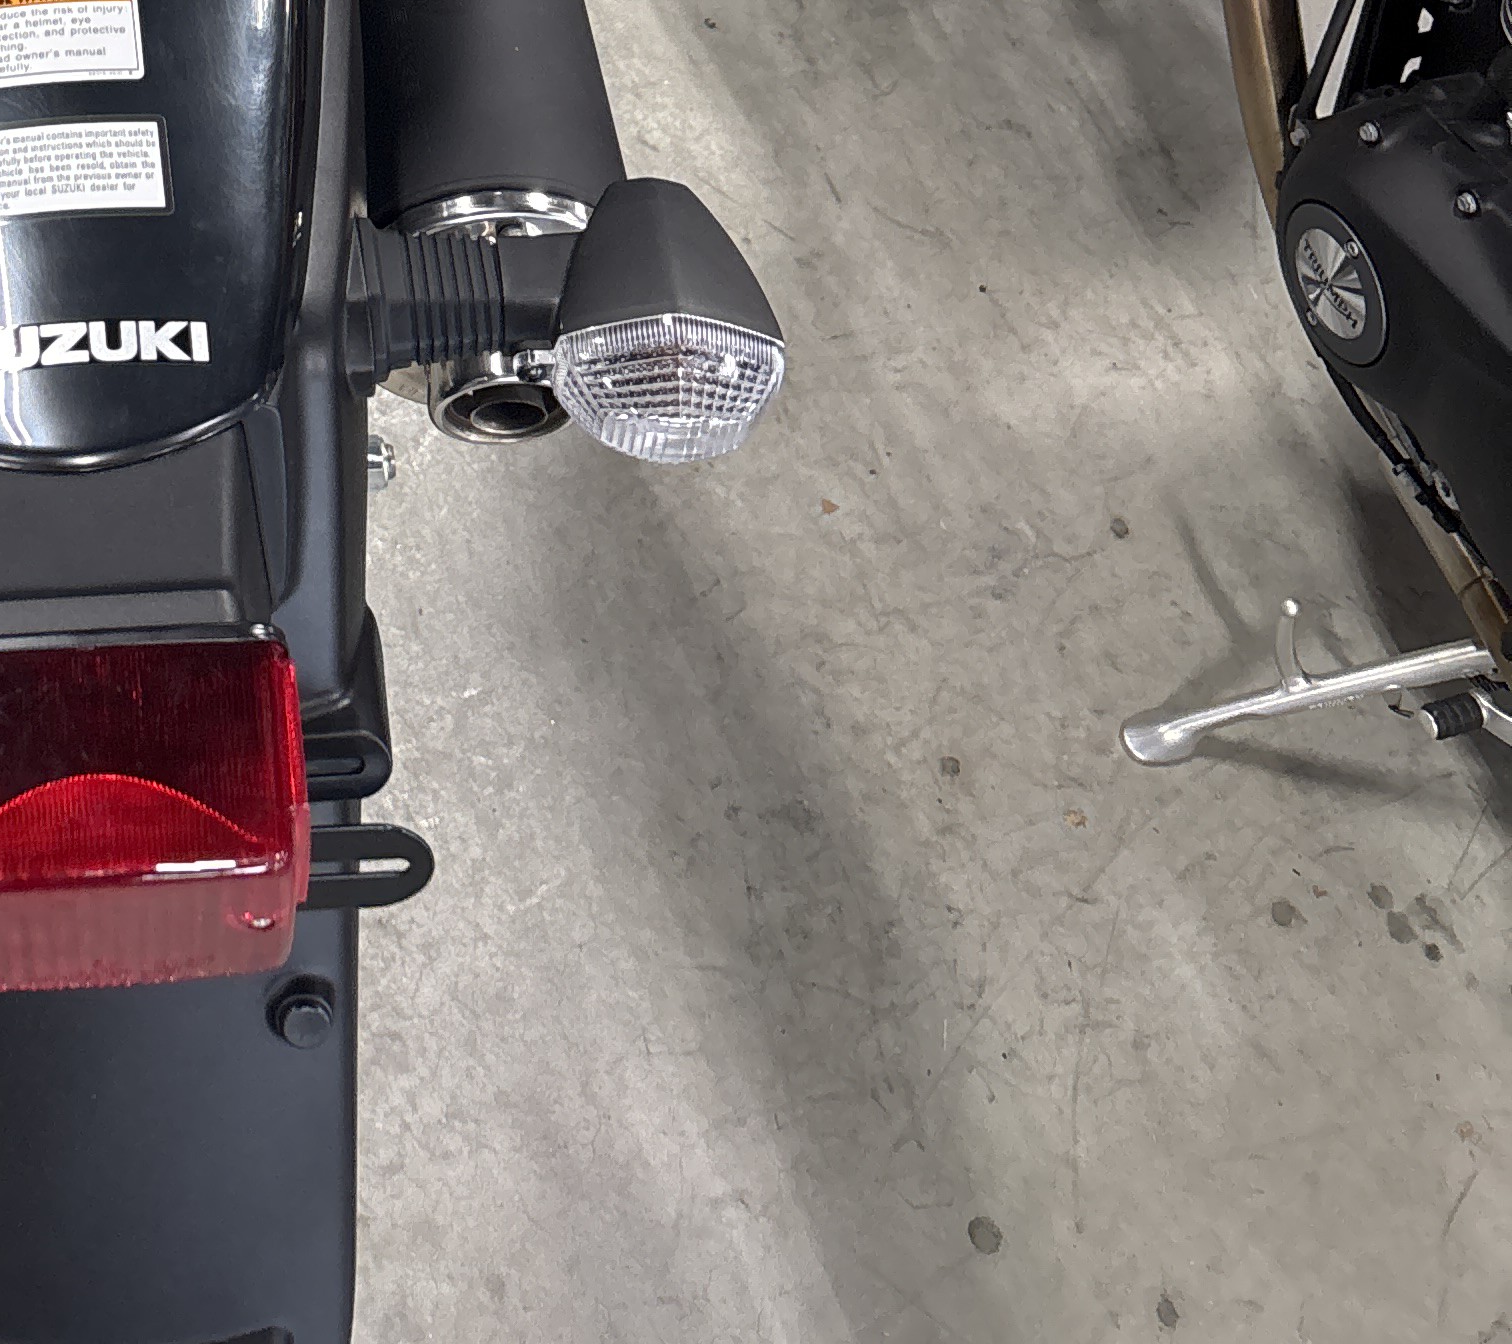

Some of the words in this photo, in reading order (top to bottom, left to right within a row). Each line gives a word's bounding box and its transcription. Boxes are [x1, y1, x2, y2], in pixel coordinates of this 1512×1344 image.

[31, 7, 48, 17] the
[53, 5, 74, 15] risk
[77, 4, 88, 14] of
[92, 4, 128, 16] injury:
[13, 21, 20, 30] a
[25, 16, 67, 29] helmet,
[70, 15, 92, 26] eye
[44, 26, 65, 37] and
[70, 24, 126, 37] protective
[15, 49, 60, 62] owner's
[64, 46, 107, 57] manual
[12, 132, 45, 144] manual
[45, 129, 83, 141] contains
[84, 128, 127, 139] important
[128, 127, 154, 139] safety
[12, 144, 29, 155] and
[30, 141, 84, 152] instructions
[85, 138, 112, 149] which
[114, 138, 144, 148] should
[145, 138, 156, 148] be
[23, 154, 52, 164] before
[54, 151, 97, 162] operating
[99, 149, 114, 159] the
[28, 164, 45, 175] has
[49, 162, 72, 173] been
[109, 159, 138, 170] obtain
[141, 159, 156, 170] the
[33, 173, 55, 185] from
[56, 173, 71, 183] the
[73, 172, 112, 183] previous
[114, 171, 143, 180] owner
[144, 171, 155, 180] or
[0, 189, 21, 202] your
[24, 185, 47, 197] local
[51, 182, 86, 195] SUZUKI
[89, 182, 119, 192] dealer
[122, 181, 136, 192] for
[1302, 237, 1359, 330] TRIUMPH
